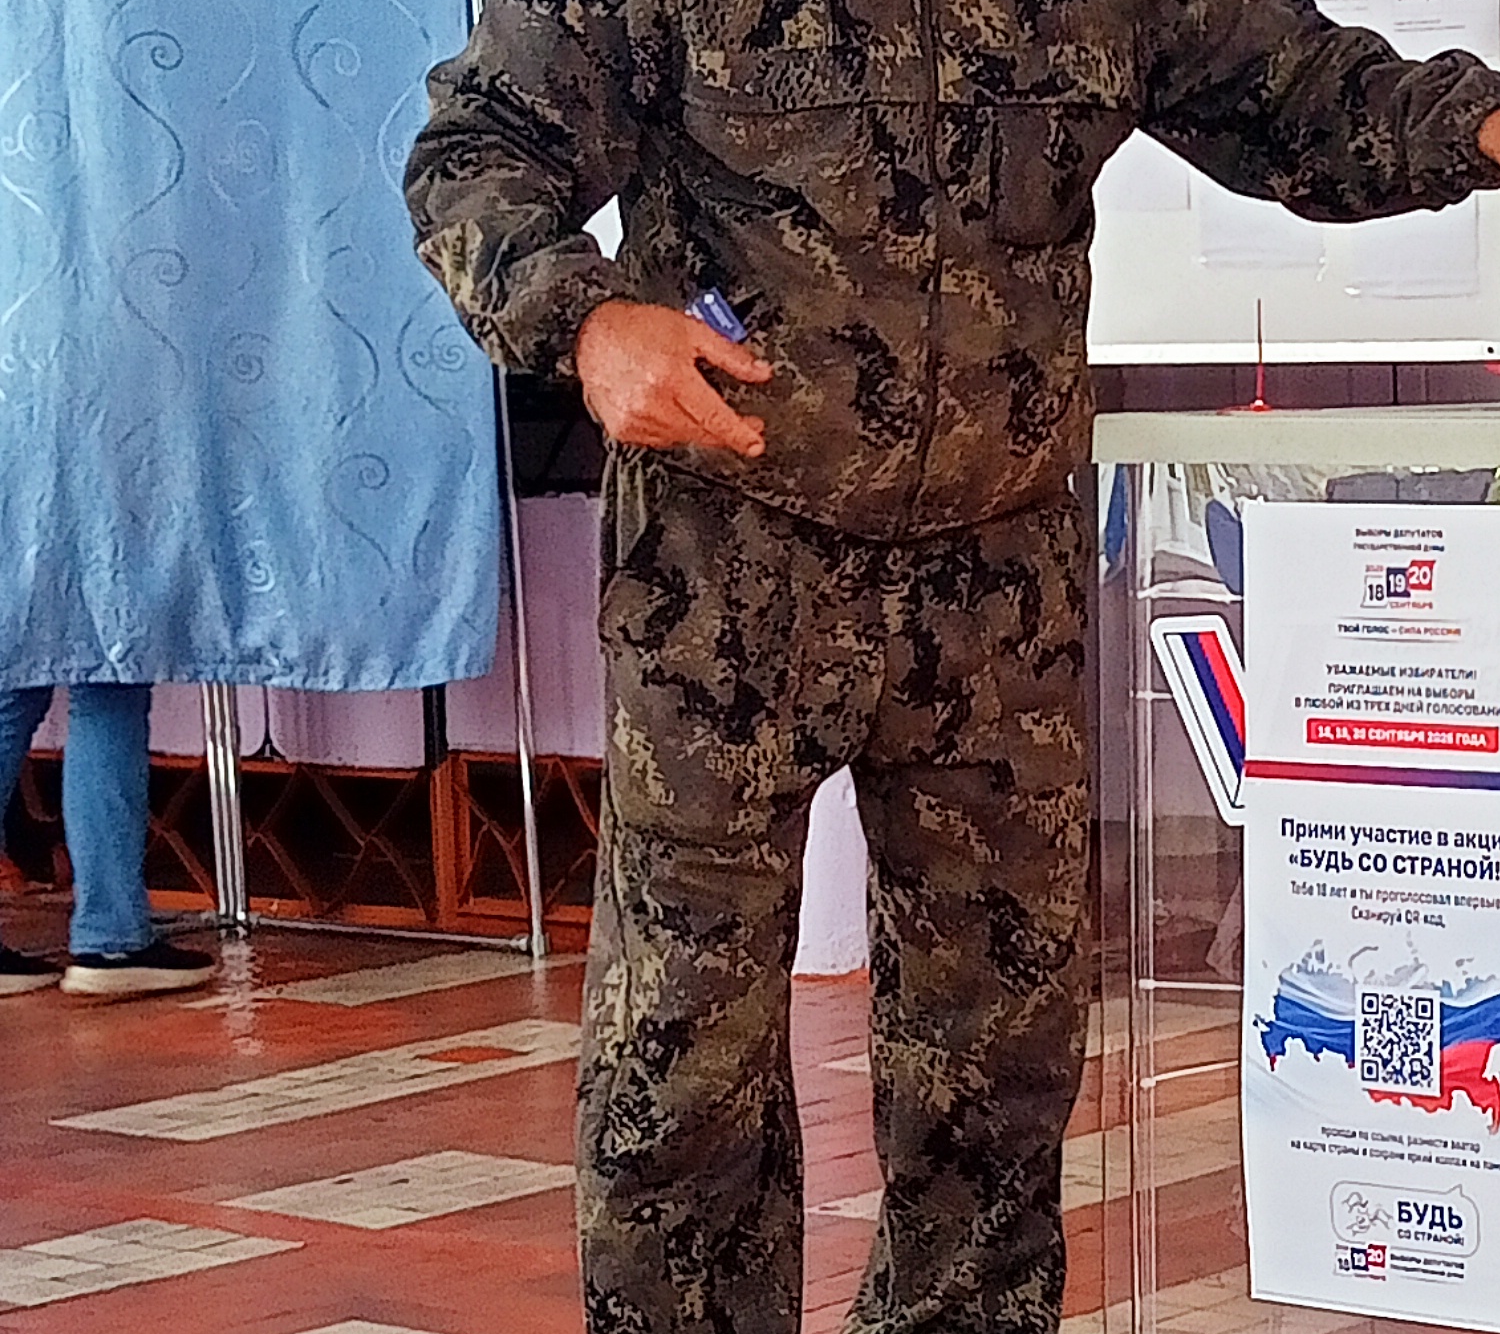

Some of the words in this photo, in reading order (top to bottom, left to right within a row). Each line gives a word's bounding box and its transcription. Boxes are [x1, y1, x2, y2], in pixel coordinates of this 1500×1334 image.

[1367, 584, 1385, 601] 18
[1388, 573, 1406, 594] 19
[1408, 565, 1431, 585] 20
[1326, 664, 1396, 677] УВАЖАЕМЫЕ
[1399, 666, 1476, 680] ИЗБИРАТЕЛИ!
[1328, 682, 1404, 697] ПРИГЛАШАЕМ
[1408, 686, 1422, 697] НА
[1425, 687, 1475, 700] ВЫБОРЫ
[1295, 697, 1301, 708] В
[1304, 696, 1343, 709] ЛЮБОЙ
[1347, 699, 1360, 710] ИЗ
[1393, 700, 1423, 714] ДНЕЙ
[1456, 732, 1487, 747] ГОДА
[1281, 818, 1345, 842] Прими
[1350, 825, 1432, 846] участие
[1437, 830, 1449, 846] в
[1289, 849, 1353, 873] «БУДЬ
[1358, 853, 1387, 874] СО
[1329, 886, 1348, 898] лет
[1359, 888, 1373, 900] ты
[1376, 889, 1451, 906] проголосовал
[1397, 1200, 1463, 1232] БУДЬ
[1397, 1228, 1411, 1240] СО
[1367, 1248, 1383, 1264] 20
